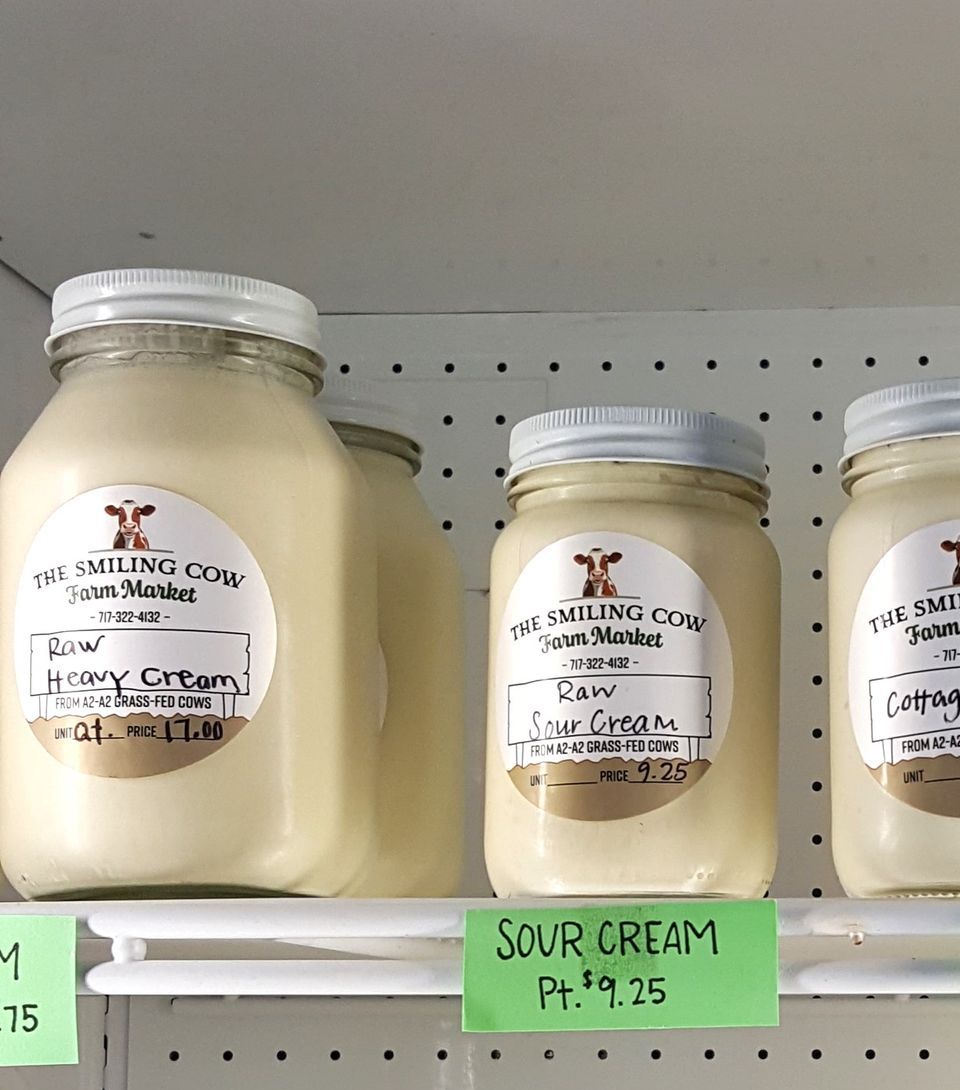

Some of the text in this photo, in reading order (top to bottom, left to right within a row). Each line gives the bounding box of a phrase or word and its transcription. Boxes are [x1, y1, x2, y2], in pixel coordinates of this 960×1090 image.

[34, 558, 246, 590] THE SMILING COW
[66, 579, 197, 604] Farm Market
[99, 611, 160, 623] 717-322-4132
[511, 604, 707, 641] THE SMILING COW
[869, 606, 908, 634] THE
[49, 635, 104, 660] Raw
[539, 627, 663, 653] Farm Market
[570, 657, 629, 669] 717-322-4132
[48, 669, 130, 696] Heavy
[557, 680, 617, 703] Raw
[114, 695, 174, 708] GRASS-FED
[127, 726, 156, 738] PRICE
[165, 720, 222, 743] 17.00
[529, 709, 678, 740] Sour Cream
[587, 740, 644, 753] GRASS-FED
[600, 761, 687, 783] PRICE 9.25
[496, 918, 719, 960] SOUR CREAM
[538, 975, 581, 1011] Pt.
